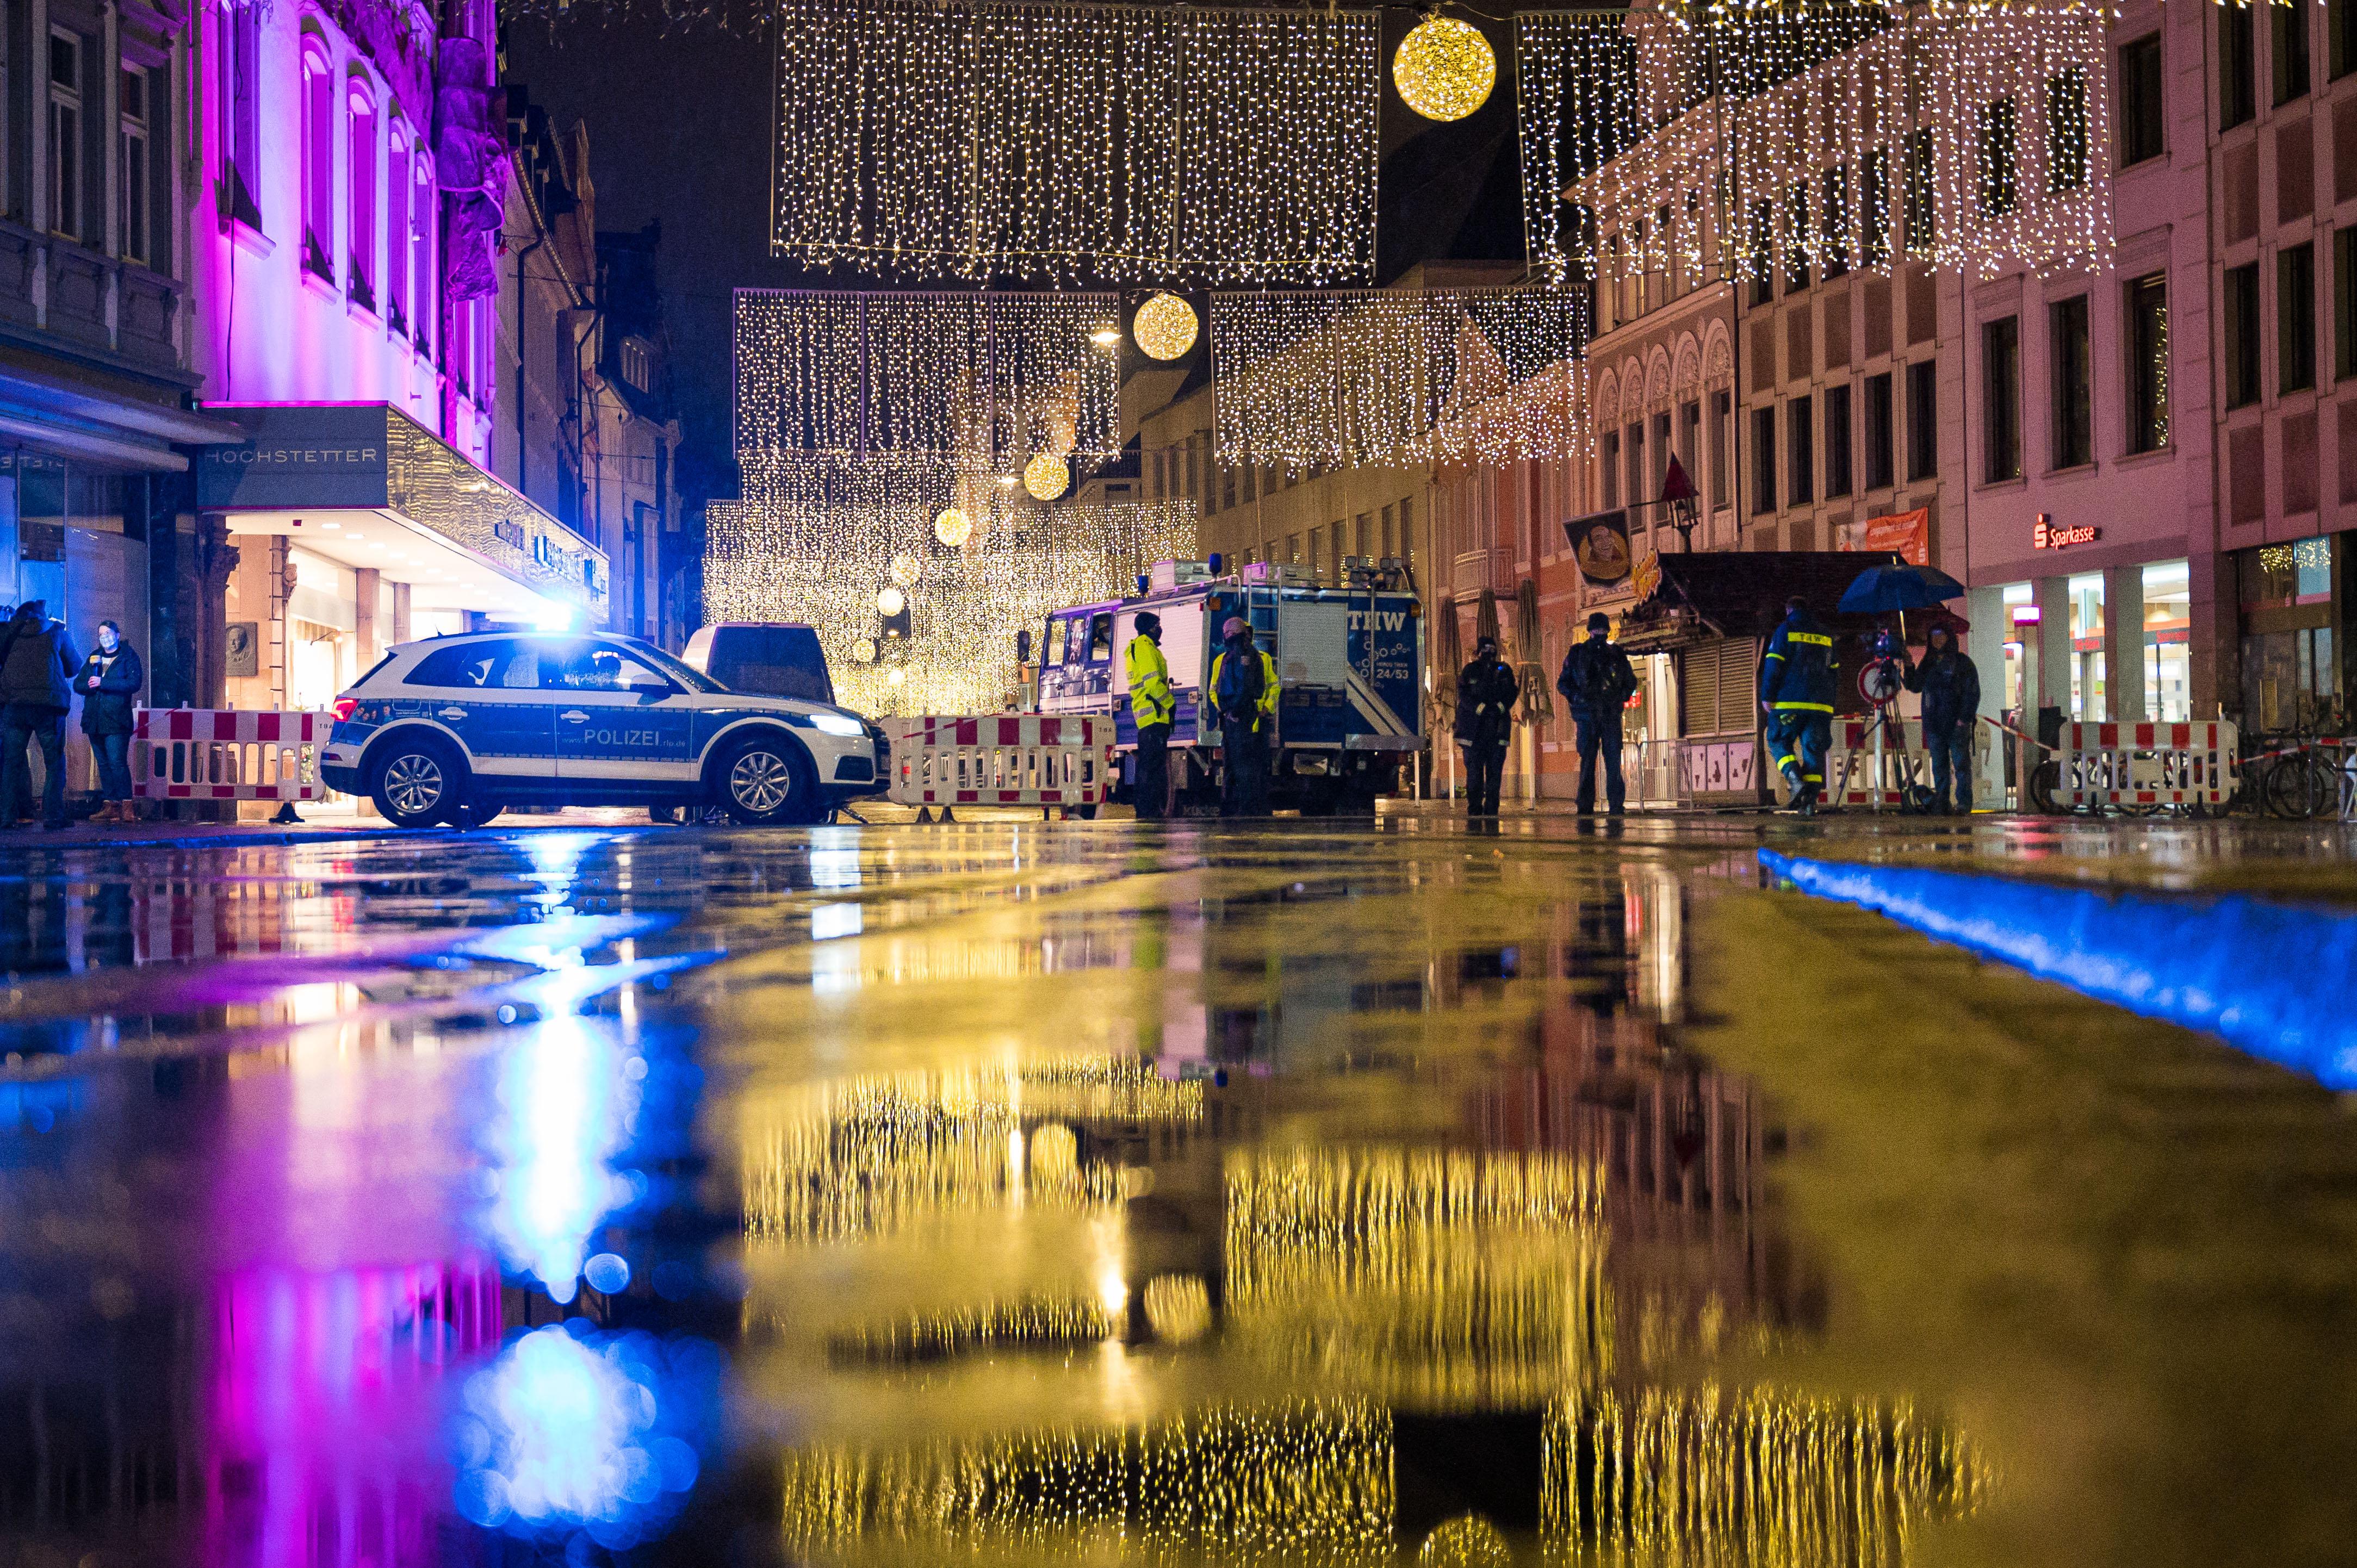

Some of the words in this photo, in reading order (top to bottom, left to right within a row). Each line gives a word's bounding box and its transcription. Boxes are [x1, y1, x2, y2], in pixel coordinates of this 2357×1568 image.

[204, 449, 377, 463] HOCHSTETTER
[2050, 525, 2094, 551] Sparkasse
[1348, 611, 1407, 631] THW
[1376, 669, 1409, 680] 24/53
